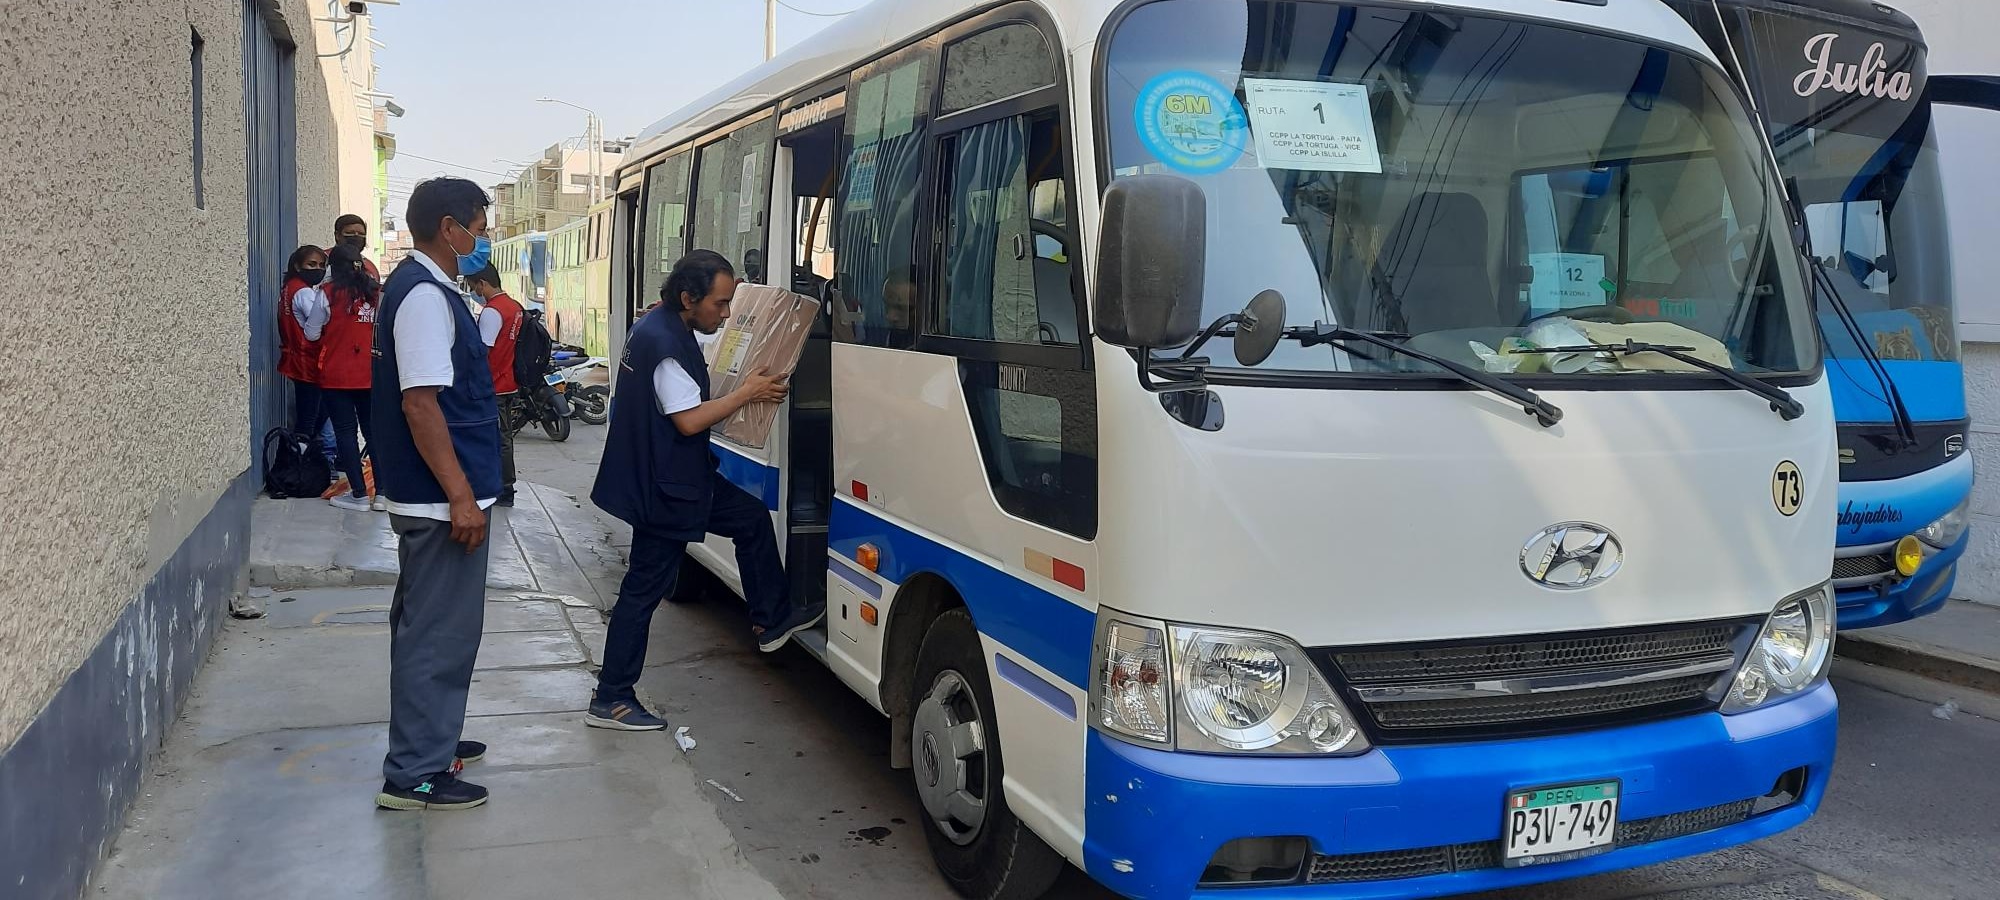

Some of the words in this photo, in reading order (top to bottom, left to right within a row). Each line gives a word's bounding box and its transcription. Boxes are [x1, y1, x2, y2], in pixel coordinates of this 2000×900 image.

[1792, 33, 1913, 101] Julia
[788, 97, 828, 132] Subida
[1166, 95, 1212, 114] 6M
[1258, 107, 1286, 115] RUTA
[1313, 102, 1326, 124] 1
[1302, 133, 1335, 141] TORTUGA
[1566, 267, 1583, 281] 12
[999, 365, 1027, 392] COUNTY
[1777, 470, 1800, 507] 73
[1837, 500, 1903, 534] abajadores
[1546, 789, 1585, 804] PERU
[1511, 799, 1613, 849] P3V-749
